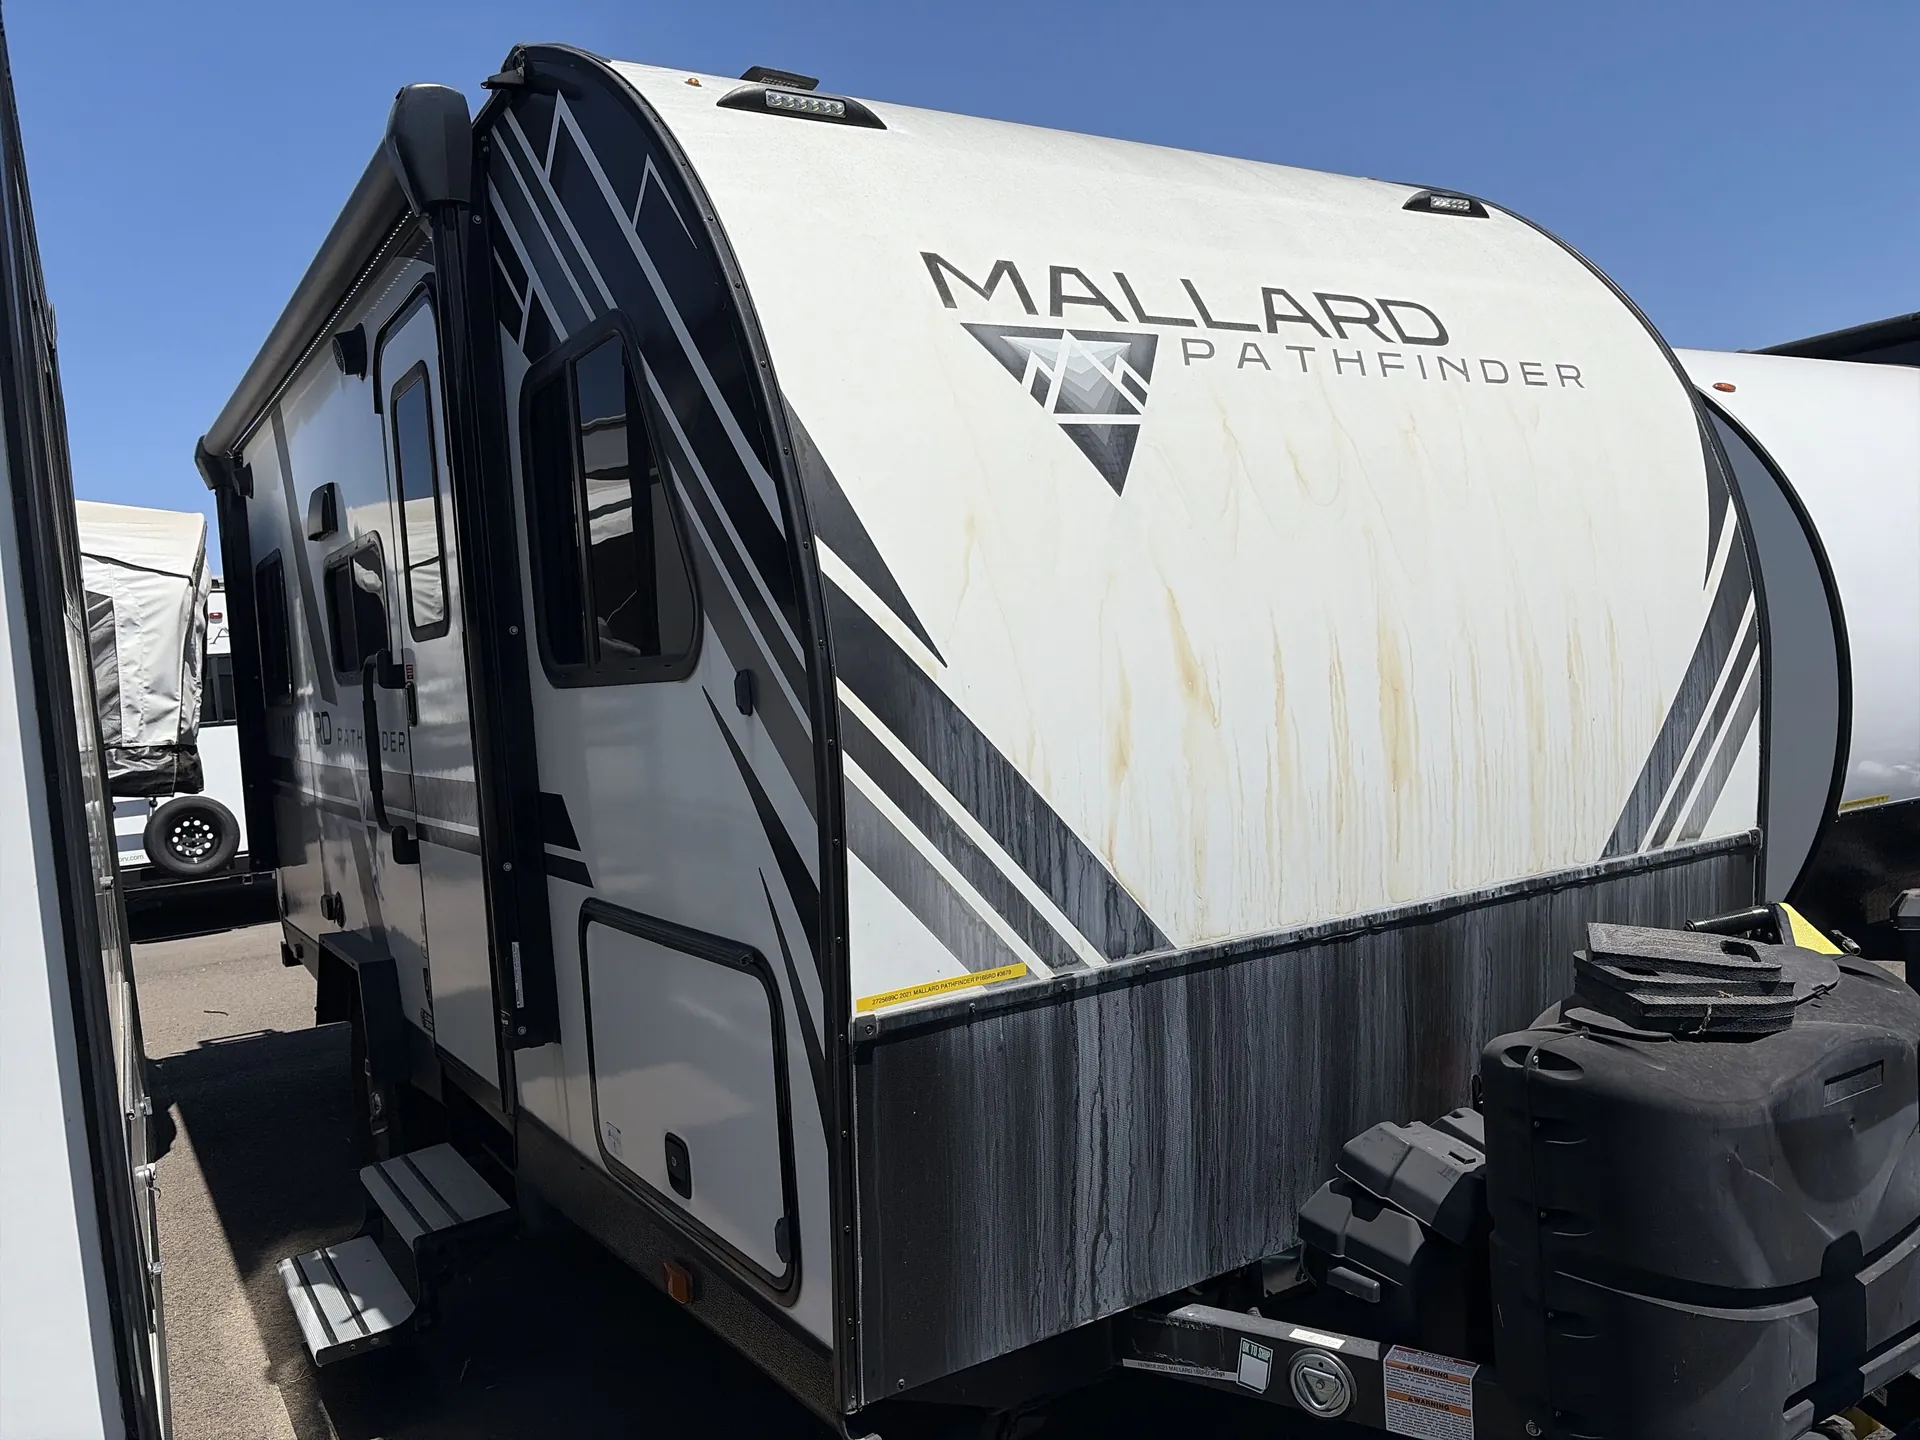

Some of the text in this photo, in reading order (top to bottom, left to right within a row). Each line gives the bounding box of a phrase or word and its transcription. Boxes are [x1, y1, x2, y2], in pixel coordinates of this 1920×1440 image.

[920, 251, 1449, 347] MALLARD
[1180, 337, 1586, 390] PATHFINDER
[899, 991, 912, 999] 2021
[913, 985, 939, 995] MALLARD
[940, 978, 975, 990] PATHFINDER
[1242, 1340, 1271, 1361] OK TO SHIP
[1413, 1365, 1449, 1379] WARNING
[1414, 1397, 1450, 1411] WARNING
